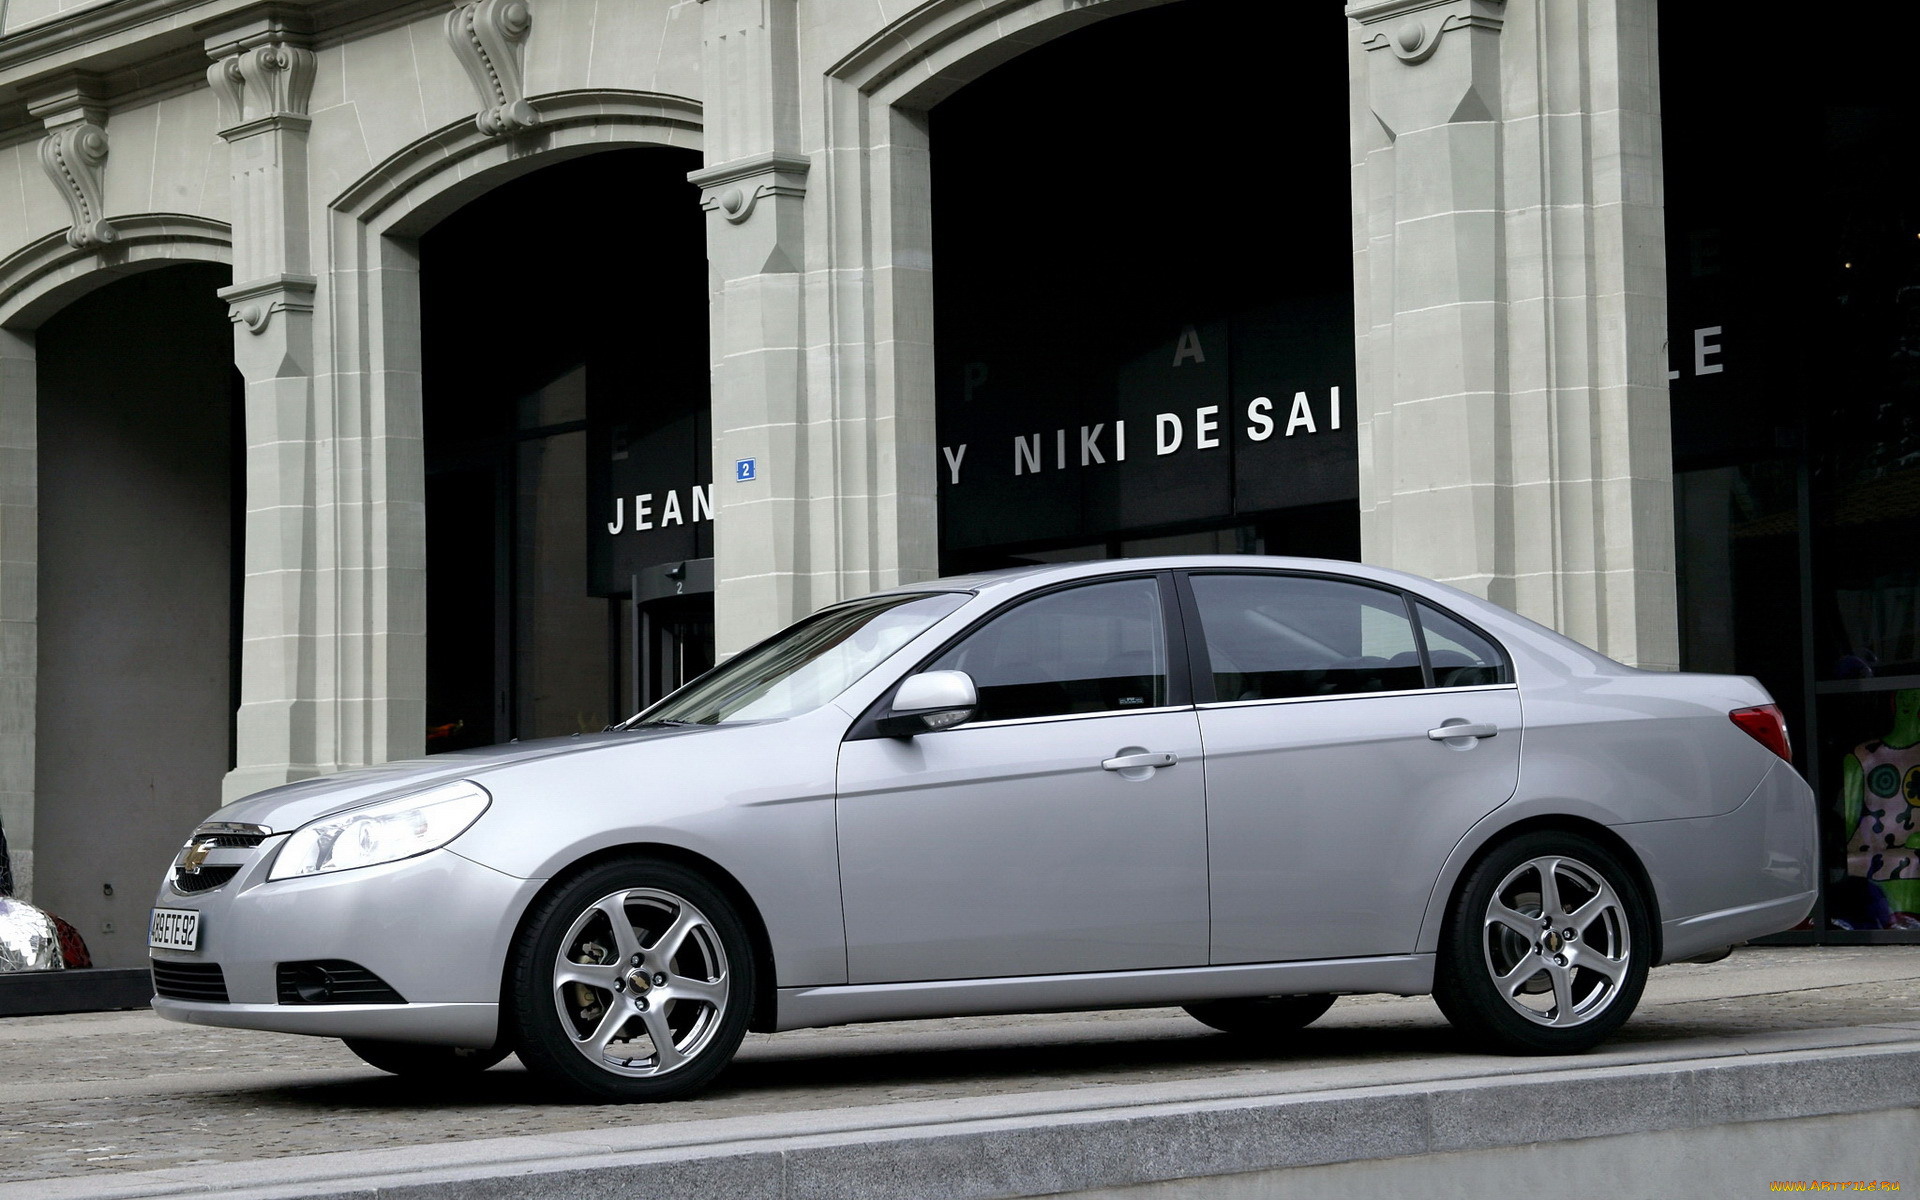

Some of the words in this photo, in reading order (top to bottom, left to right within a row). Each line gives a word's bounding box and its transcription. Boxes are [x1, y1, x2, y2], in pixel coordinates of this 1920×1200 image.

[1172, 323, 1206, 368] A
[607, 483, 715, 536] JEAN
[1013, 419, 1127, 477] NIKI
[1155, 405, 1221, 456] DE
[1246, 385, 1341, 442] SAI
[742, 463, 750, 476] 2
[676, 581, 683, 594] 2
